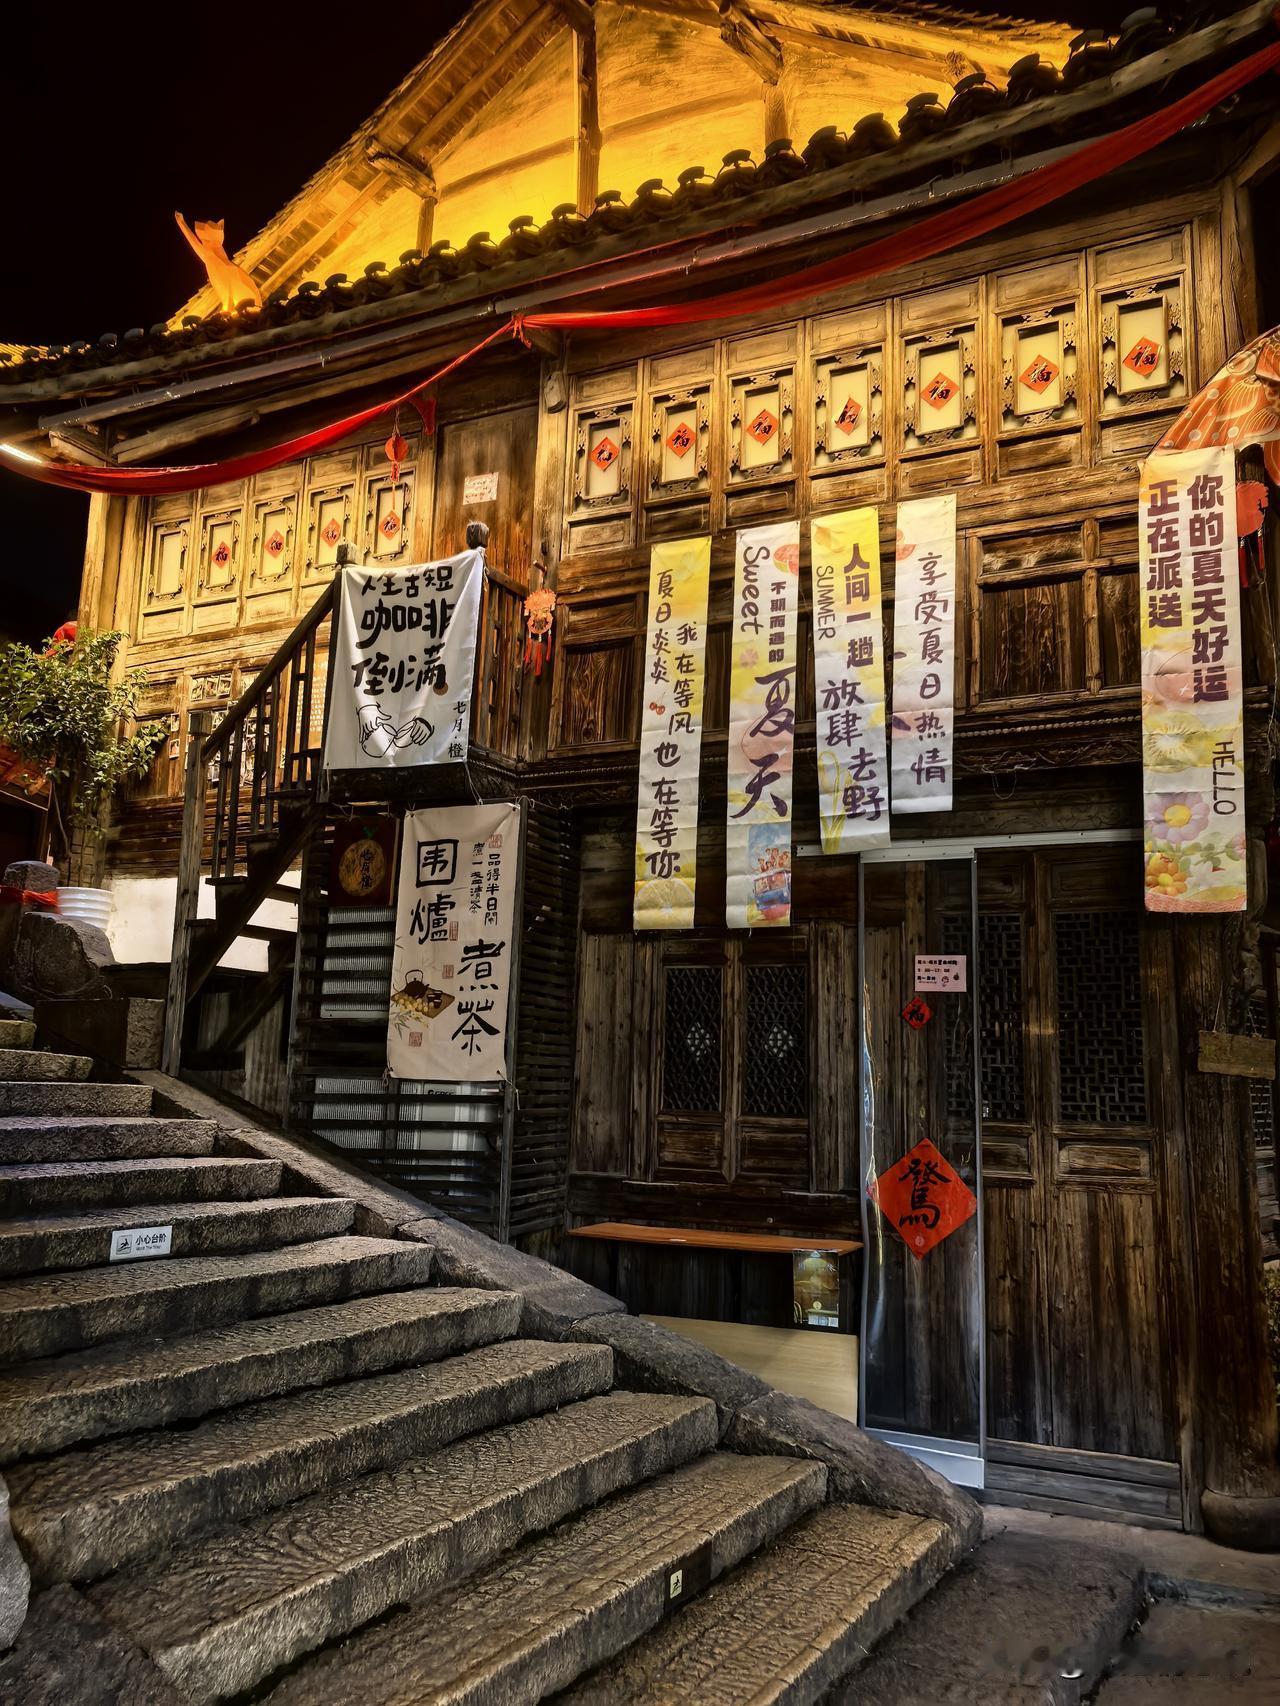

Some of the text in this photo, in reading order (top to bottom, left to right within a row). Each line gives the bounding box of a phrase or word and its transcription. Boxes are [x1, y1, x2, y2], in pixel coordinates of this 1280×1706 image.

[361, 565, 454, 599] 人生苦短
[740, 546, 771, 636] Sweet
[816, 565, 836, 641] SUMMER
[843, 543, 874, 670] 人间一趟
[1146, 479, 1183, 629] 正在派送
[1187, 474, 1229, 704] 你的夏天好运
[351, 642, 447, 697] 倒满
[355, 598, 456, 650] 咖啡
[650, 568, 675, 685] 夏日炎炎
[910, 551, 948, 785] 享受夏日热情
[729, 666, 797, 819] 夏天
[820, 679, 885, 821] 放肆去野
[1213, 741, 1237, 815] HELLO
[451, 938, 506, 1056] 煮茶
[135, 1233, 167, 1245] 小心台阶
